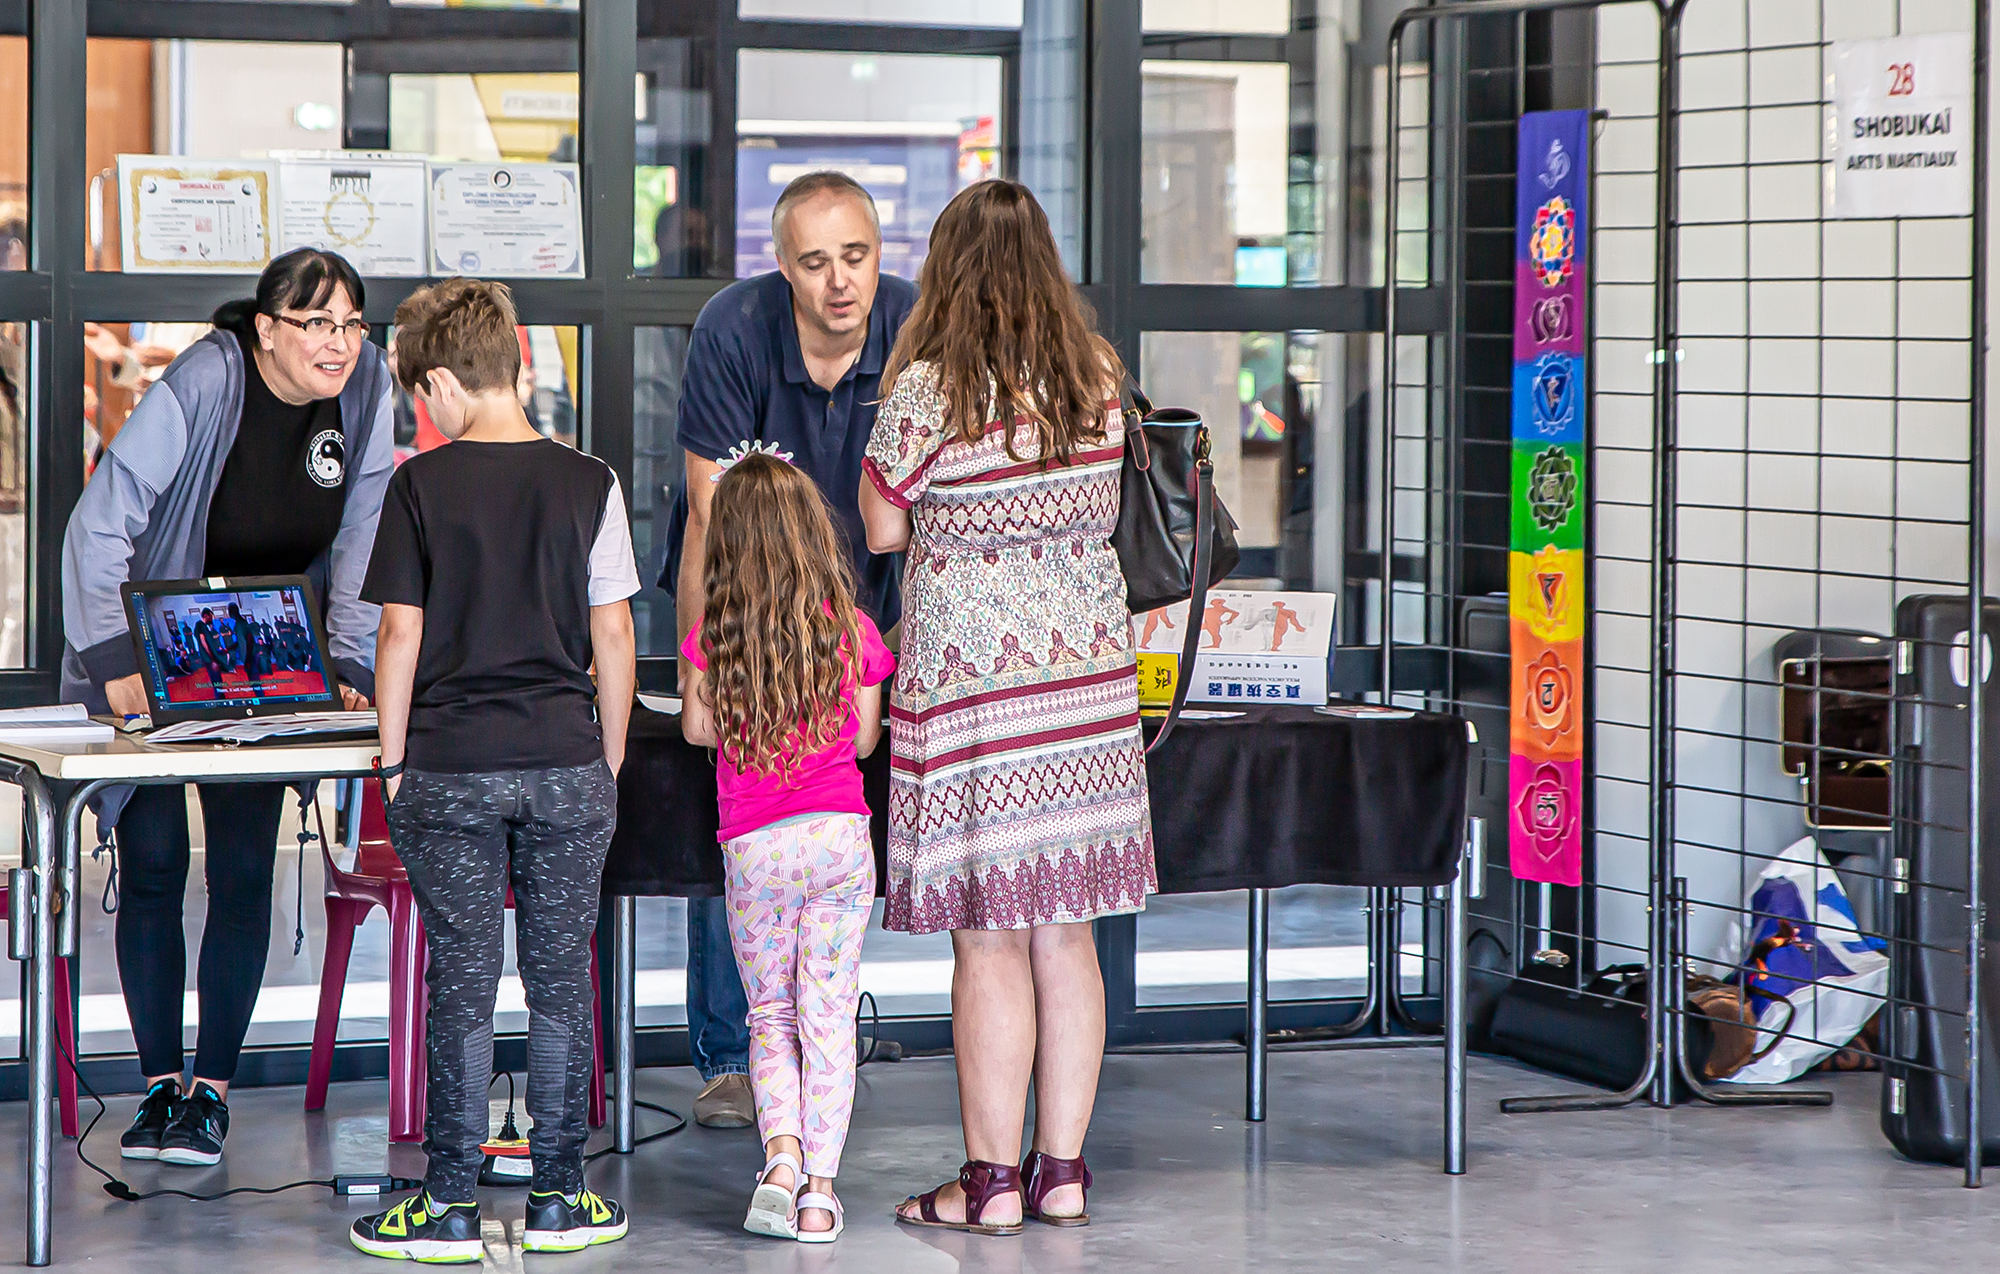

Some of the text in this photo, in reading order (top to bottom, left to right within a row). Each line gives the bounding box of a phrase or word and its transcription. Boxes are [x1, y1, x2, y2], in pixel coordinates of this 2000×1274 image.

[1887, 62, 1915, 97] 28
[1854, 107, 1952, 138] SHOBUKAÏ
[1847, 150, 1958, 170] ARTS MARTIAUX
